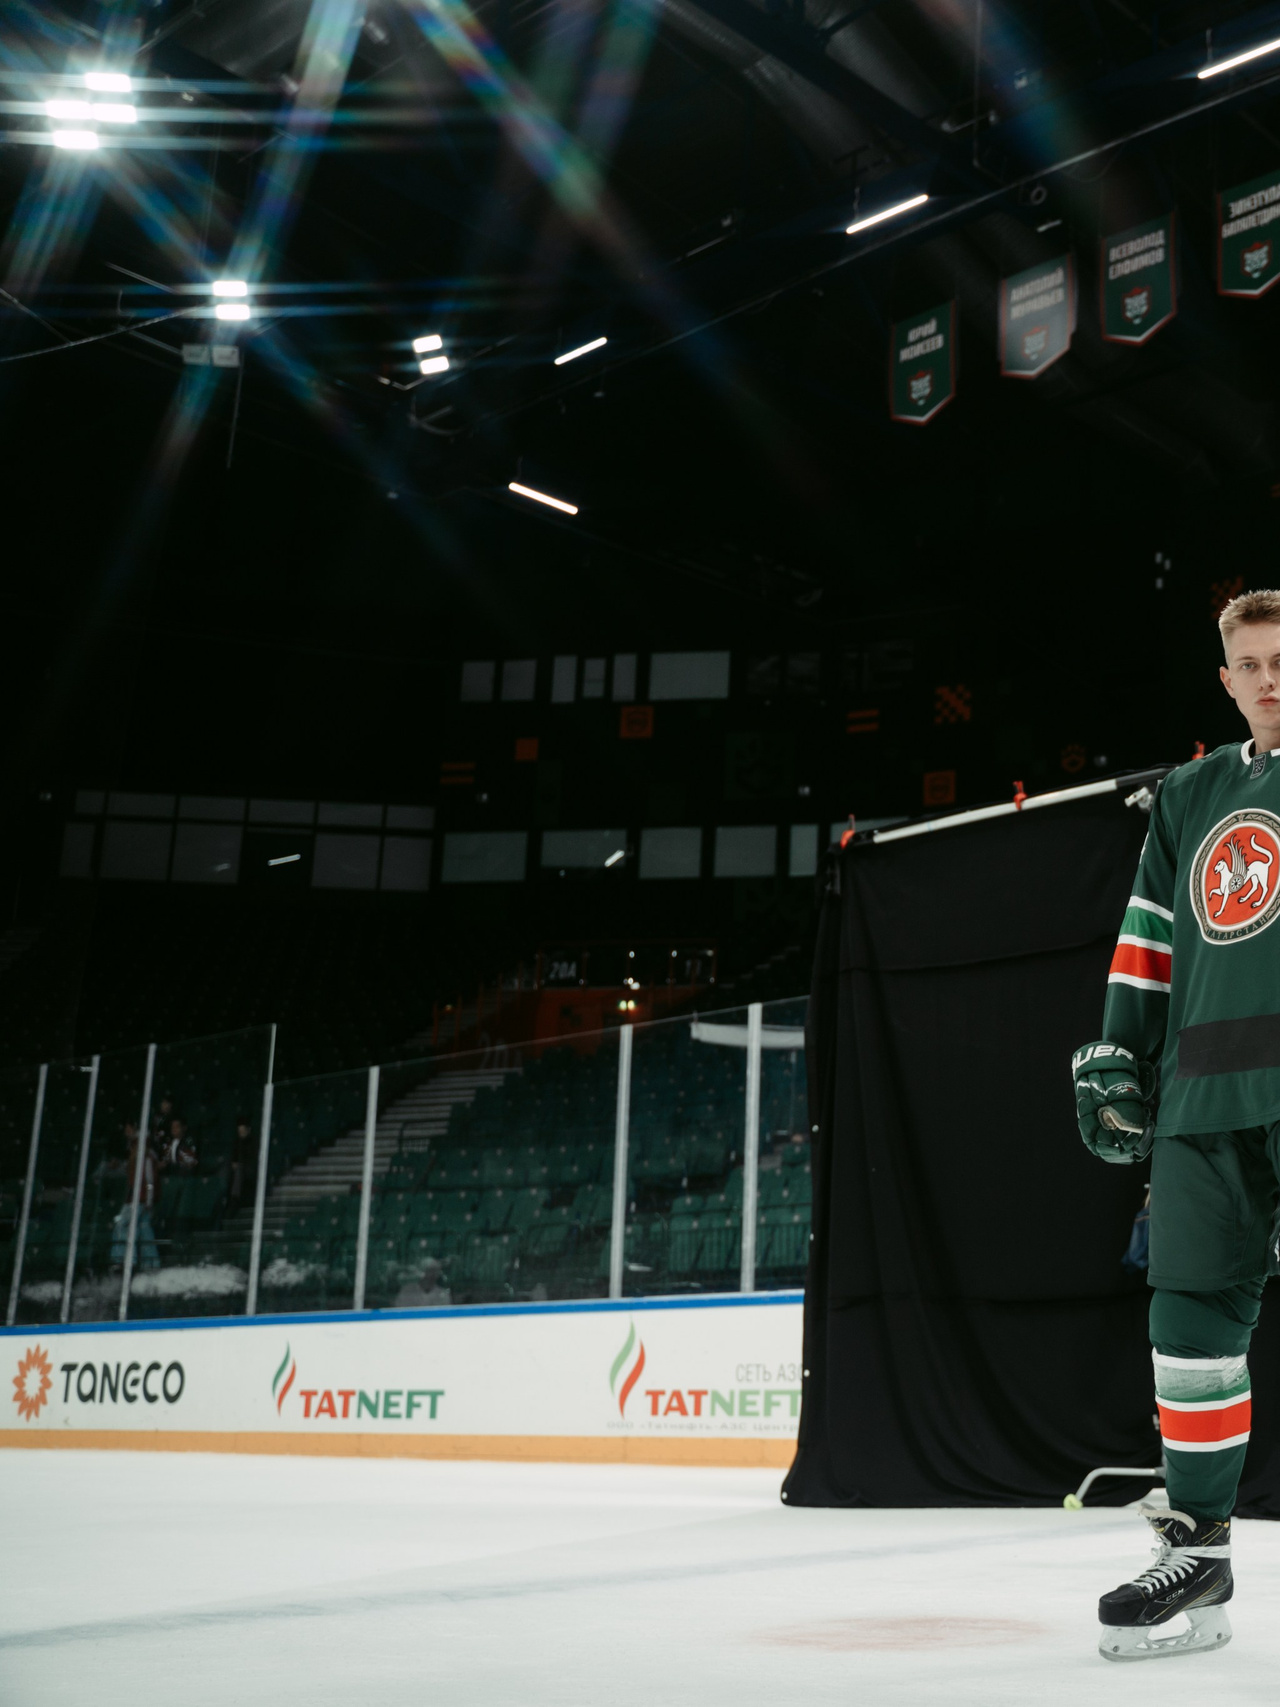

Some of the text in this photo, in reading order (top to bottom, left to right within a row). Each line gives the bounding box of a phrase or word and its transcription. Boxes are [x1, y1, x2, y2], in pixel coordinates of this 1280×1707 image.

[735, 1363, 772, 1383] СЕТЬ
[300, 1389, 445, 1420] TATNEFT
[645, 1388, 803, 1418] TATNEFT
